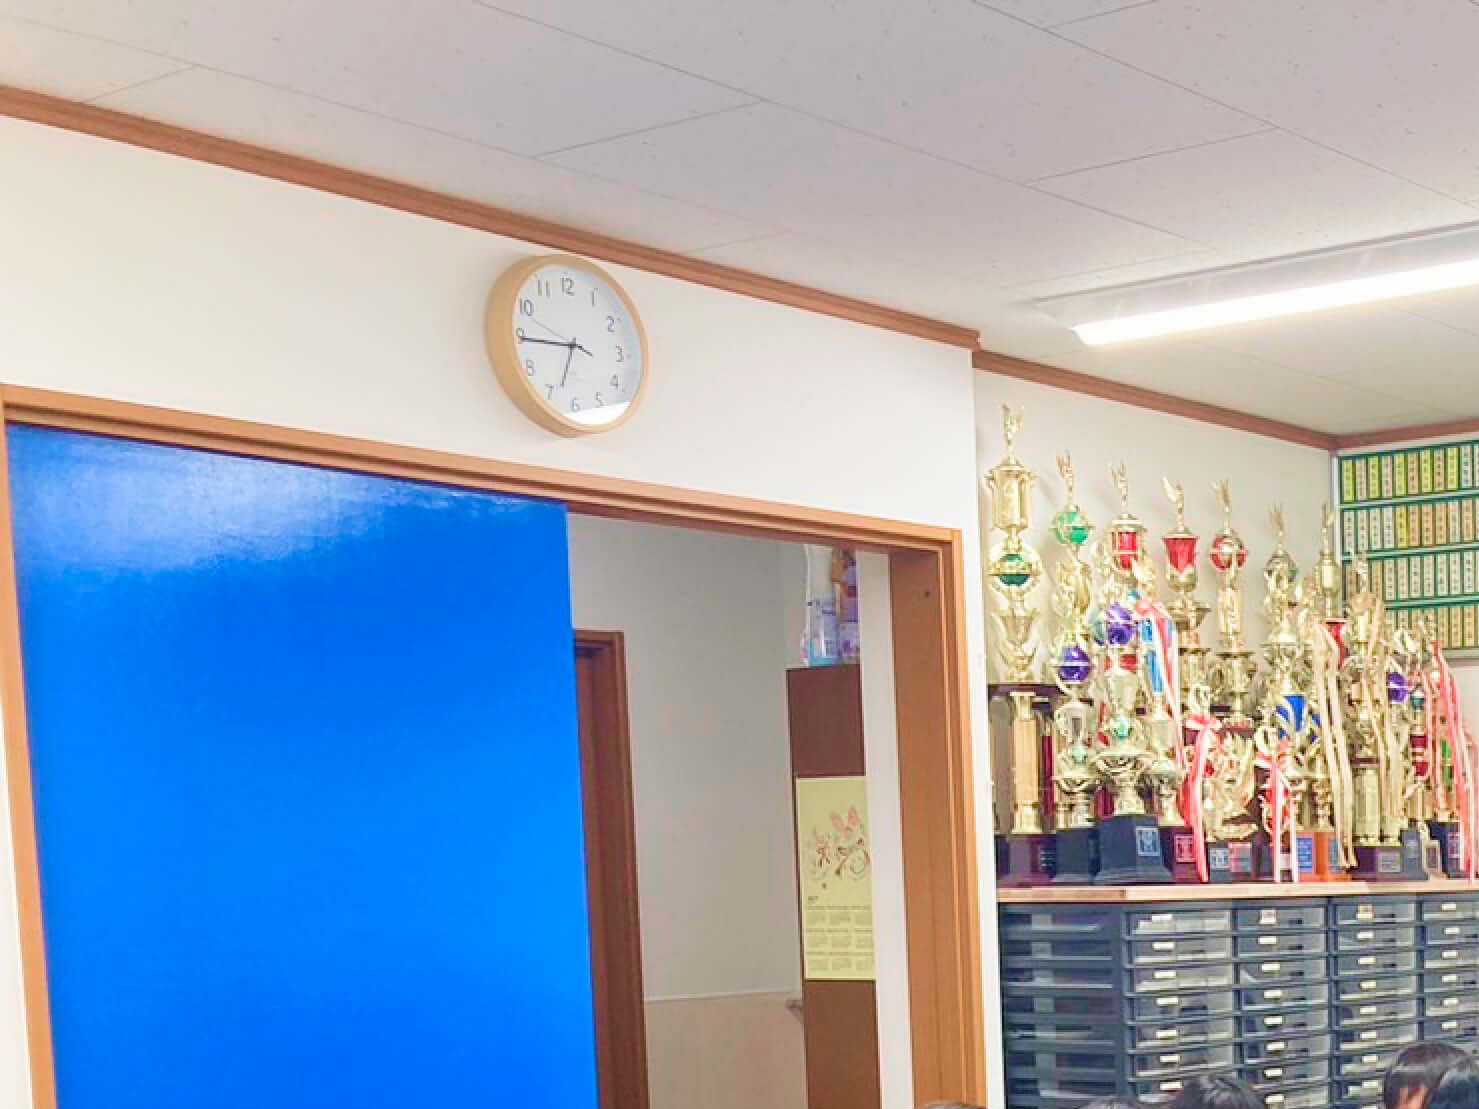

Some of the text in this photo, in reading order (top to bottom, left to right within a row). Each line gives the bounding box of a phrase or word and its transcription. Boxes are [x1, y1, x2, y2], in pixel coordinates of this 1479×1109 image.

[537, 279, 550, 297] 11
[561, 277, 575, 296] 12
[591, 288, 598, 307] 1
[519, 298, 534, 316] 10
[606, 315, 616, 333] 2
[515, 328, 525, 344] 9
[615, 346, 624, 362] 3
[525, 360, 535, 376] 8
[610, 375, 619, 389] 4
[545, 384, 554, 400] 7
[595, 392, 603, 407] 5
[571, 397, 581, 412] 6
